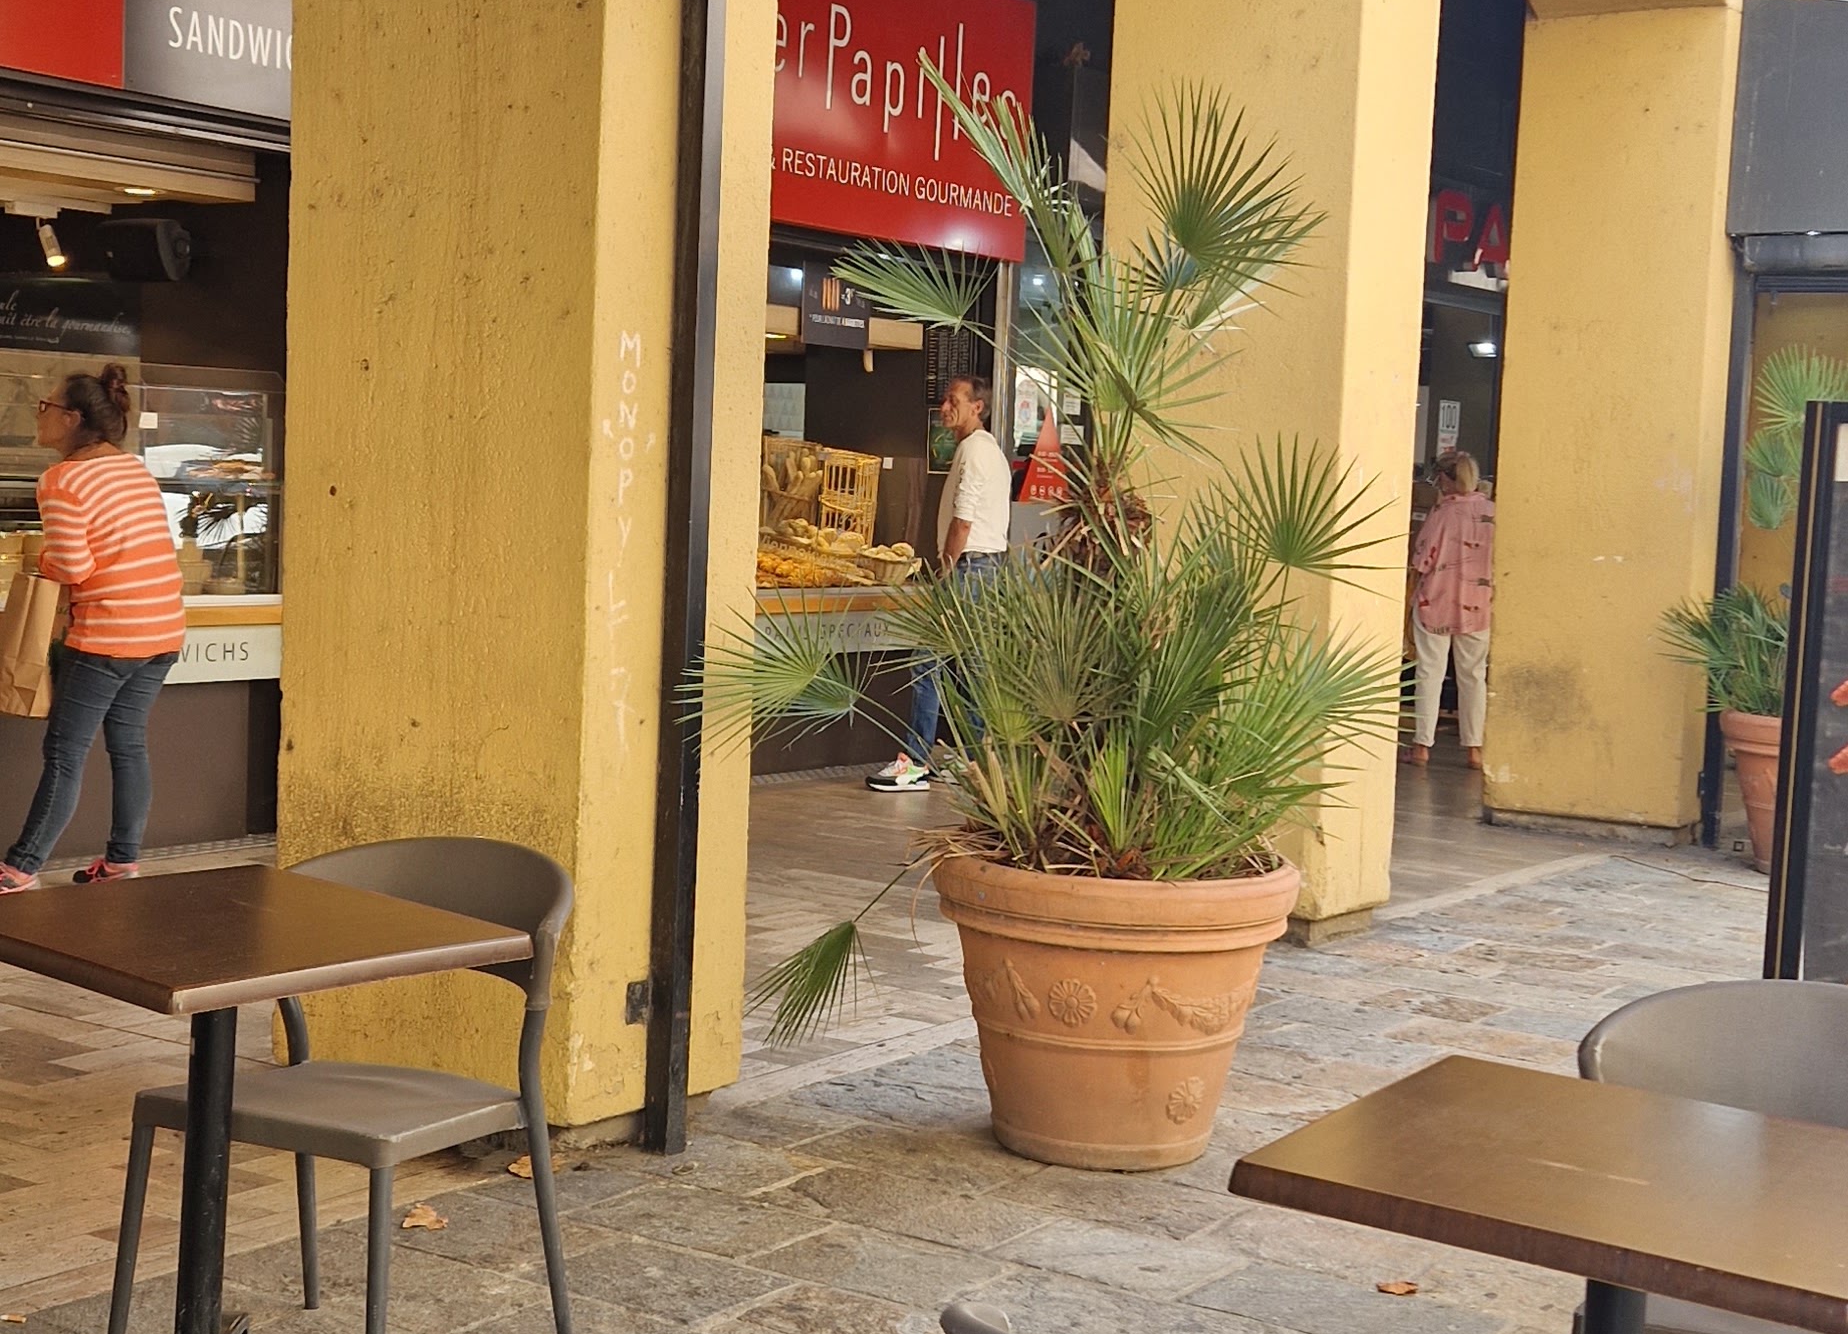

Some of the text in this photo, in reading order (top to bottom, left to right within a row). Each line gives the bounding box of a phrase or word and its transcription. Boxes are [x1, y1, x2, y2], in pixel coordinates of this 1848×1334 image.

[782, 147, 909, 197] RESTAURATION
[914, 175, 1013, 218] GOURMANDE
[1434, 189, 1509, 278] PA
[820, 621, 890, 640] SPECAUX
